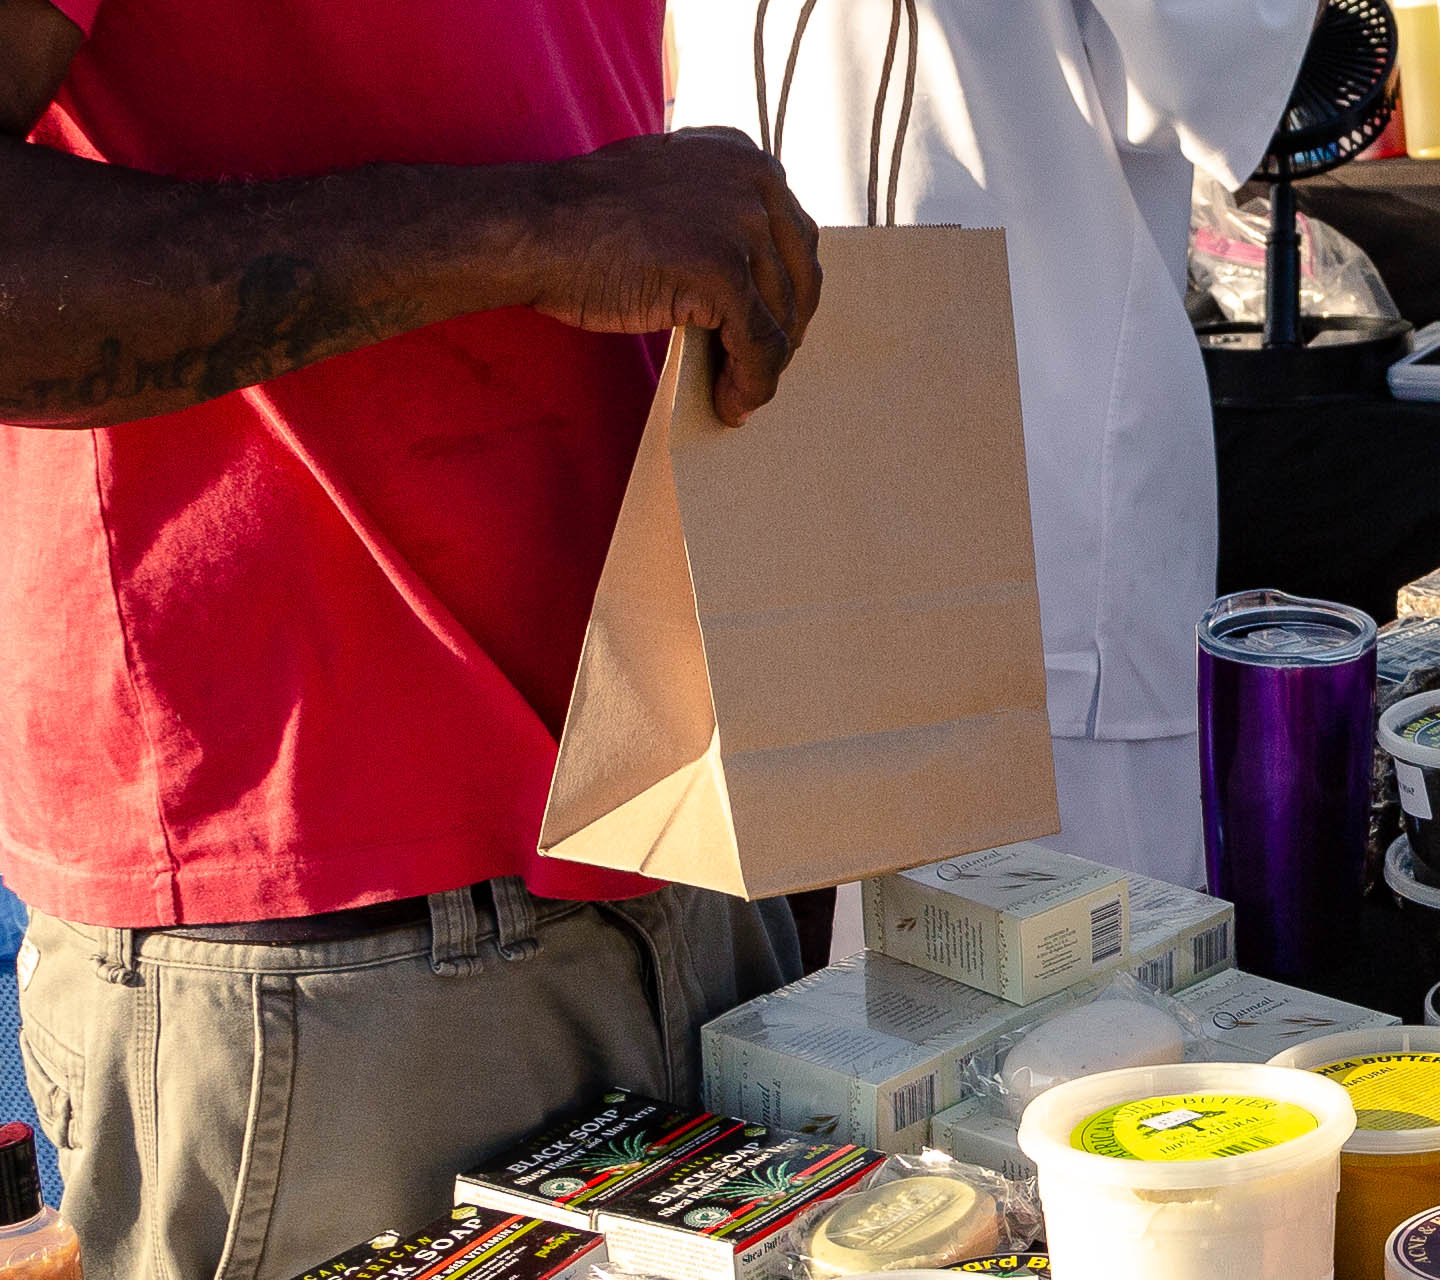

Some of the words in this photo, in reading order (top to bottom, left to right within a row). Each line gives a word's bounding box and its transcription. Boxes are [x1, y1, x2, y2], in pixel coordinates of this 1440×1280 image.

[1213, 996, 1274, 1030] Oatmeal
[413, 1217, 483, 1265] SOAP
[445, 1256, 468, 1278] with
[465, 1228, 514, 1266] VITAMIN
[512, 1222, 524, 1233] E
[1409, 1233, 1431, 1264] ACNE
